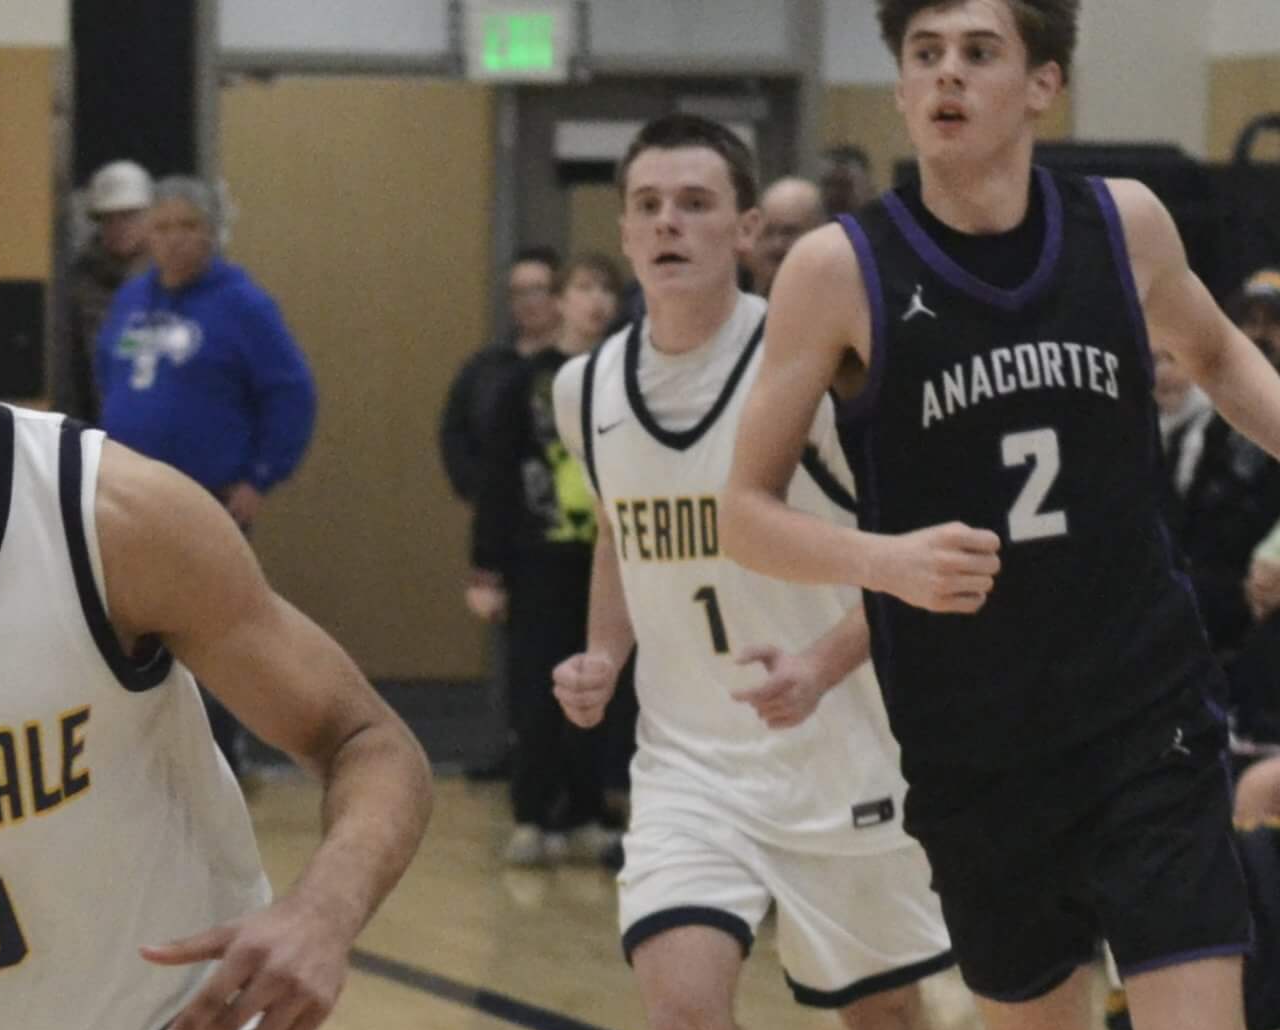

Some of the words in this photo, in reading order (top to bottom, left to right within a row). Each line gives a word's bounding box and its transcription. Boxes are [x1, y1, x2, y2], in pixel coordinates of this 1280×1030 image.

[921, 341, 1119, 429] ANACORTES
[1001, 428, 1068, 542] 2
[615, 496, 723, 563] FERND
[692, 585, 730, 655] 1
